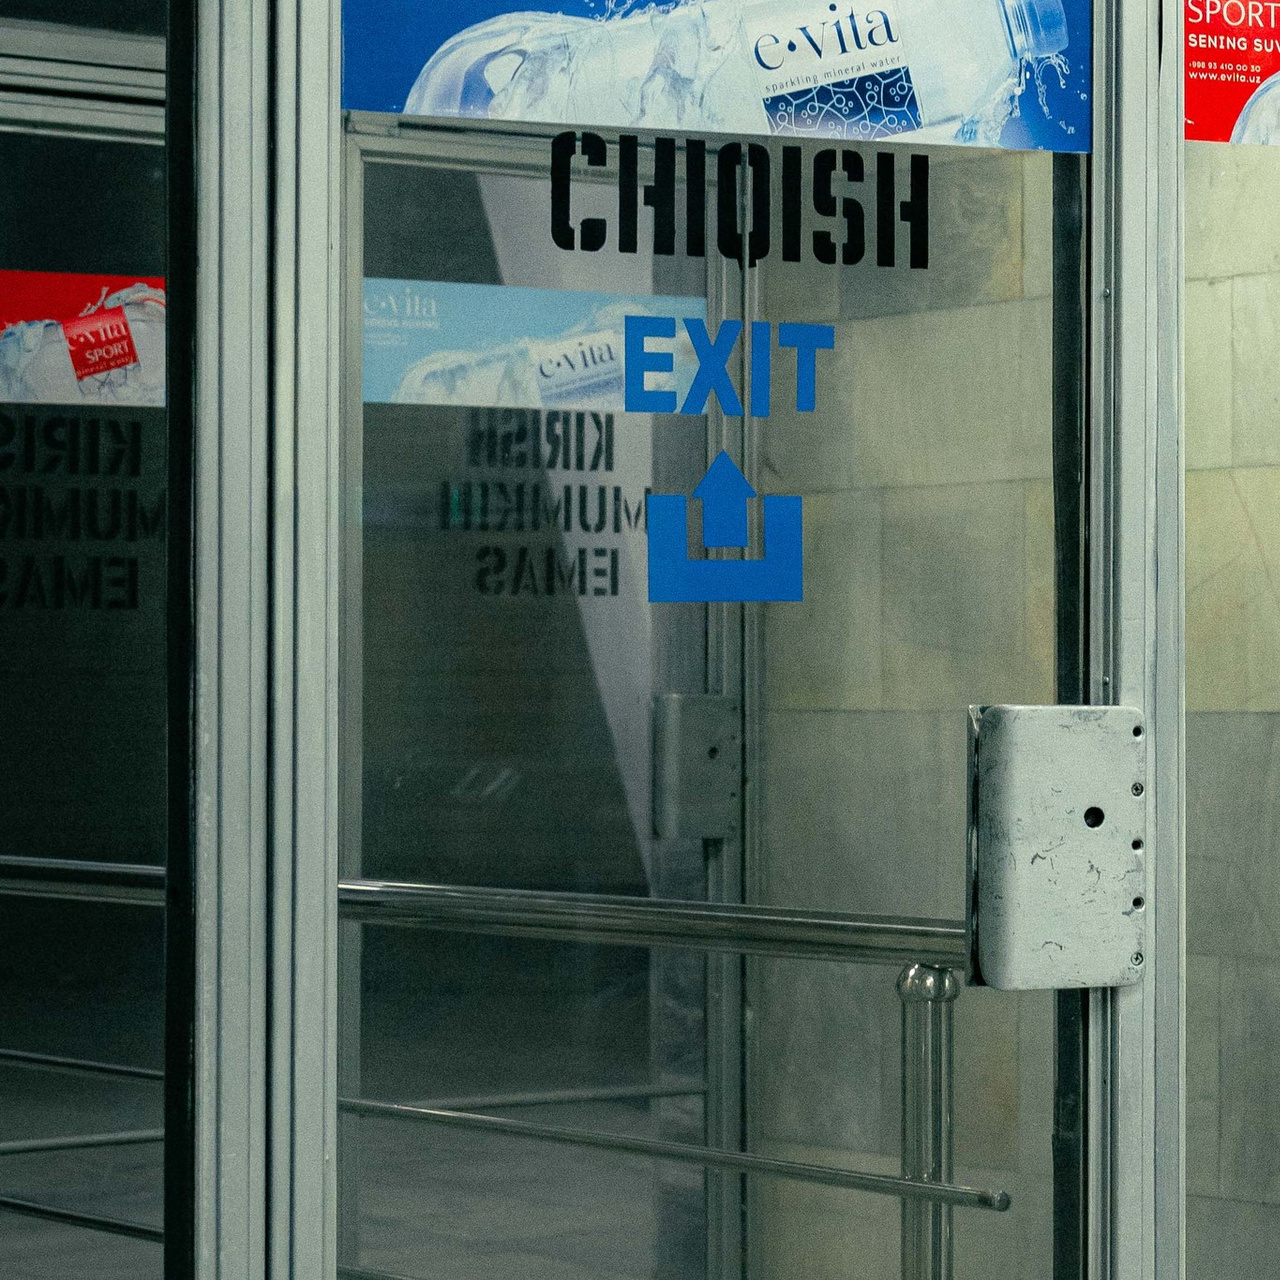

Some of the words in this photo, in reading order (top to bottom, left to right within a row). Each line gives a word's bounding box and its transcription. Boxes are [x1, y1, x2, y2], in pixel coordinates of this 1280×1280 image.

[1188, 33, 1248, 51] SENING
[765, 73, 819, 93] sparkling
[823, 61, 867, 80] mineral
[870, 55, 901, 68] water
[1188, 71, 1261, 84] www.evita.uz
[1207, 62, 1218, 70] 93
[1220, 63, 1234, 71] 410
[1235, 64, 1248, 72] 00
[1250, 65, 1261, 73] 30
[551, 131, 929, 270] CHIQISH
[85, 340, 129, 364] SPORT
[624, 315, 835, 418] EXIT
